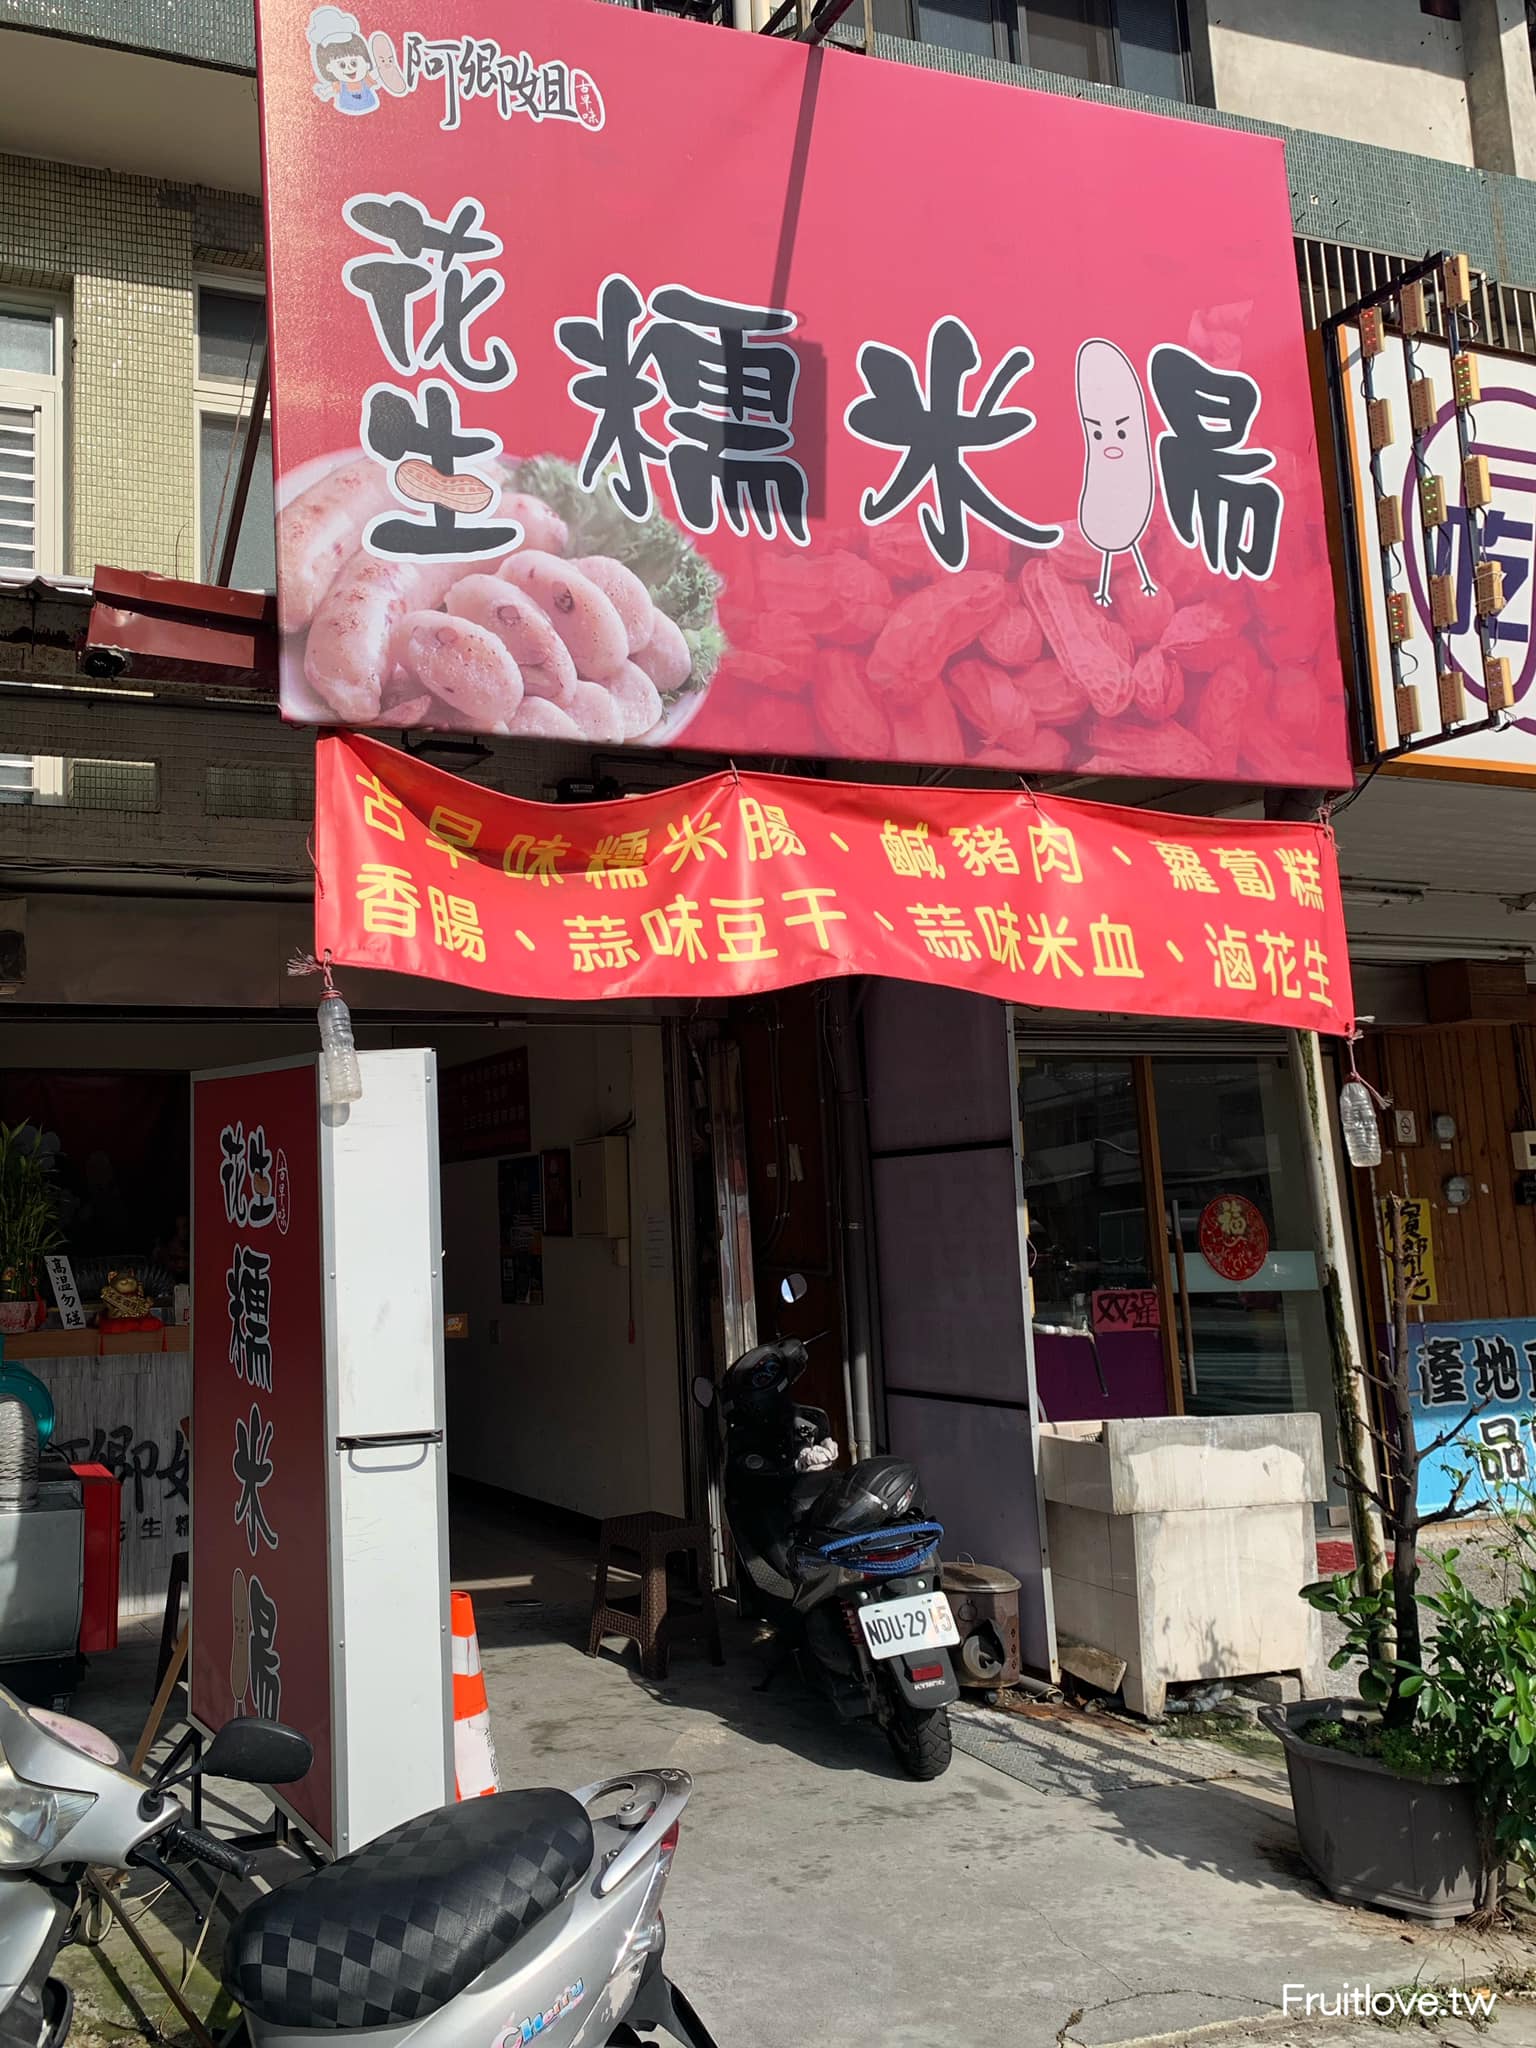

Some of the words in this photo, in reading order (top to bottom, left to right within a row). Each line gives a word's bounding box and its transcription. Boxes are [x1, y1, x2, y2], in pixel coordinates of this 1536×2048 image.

[576, 80, 599, 124] 古早味
[345, 195, 522, 561] 花生
[51, 1256, 85, 1327] 高溫勿碰
